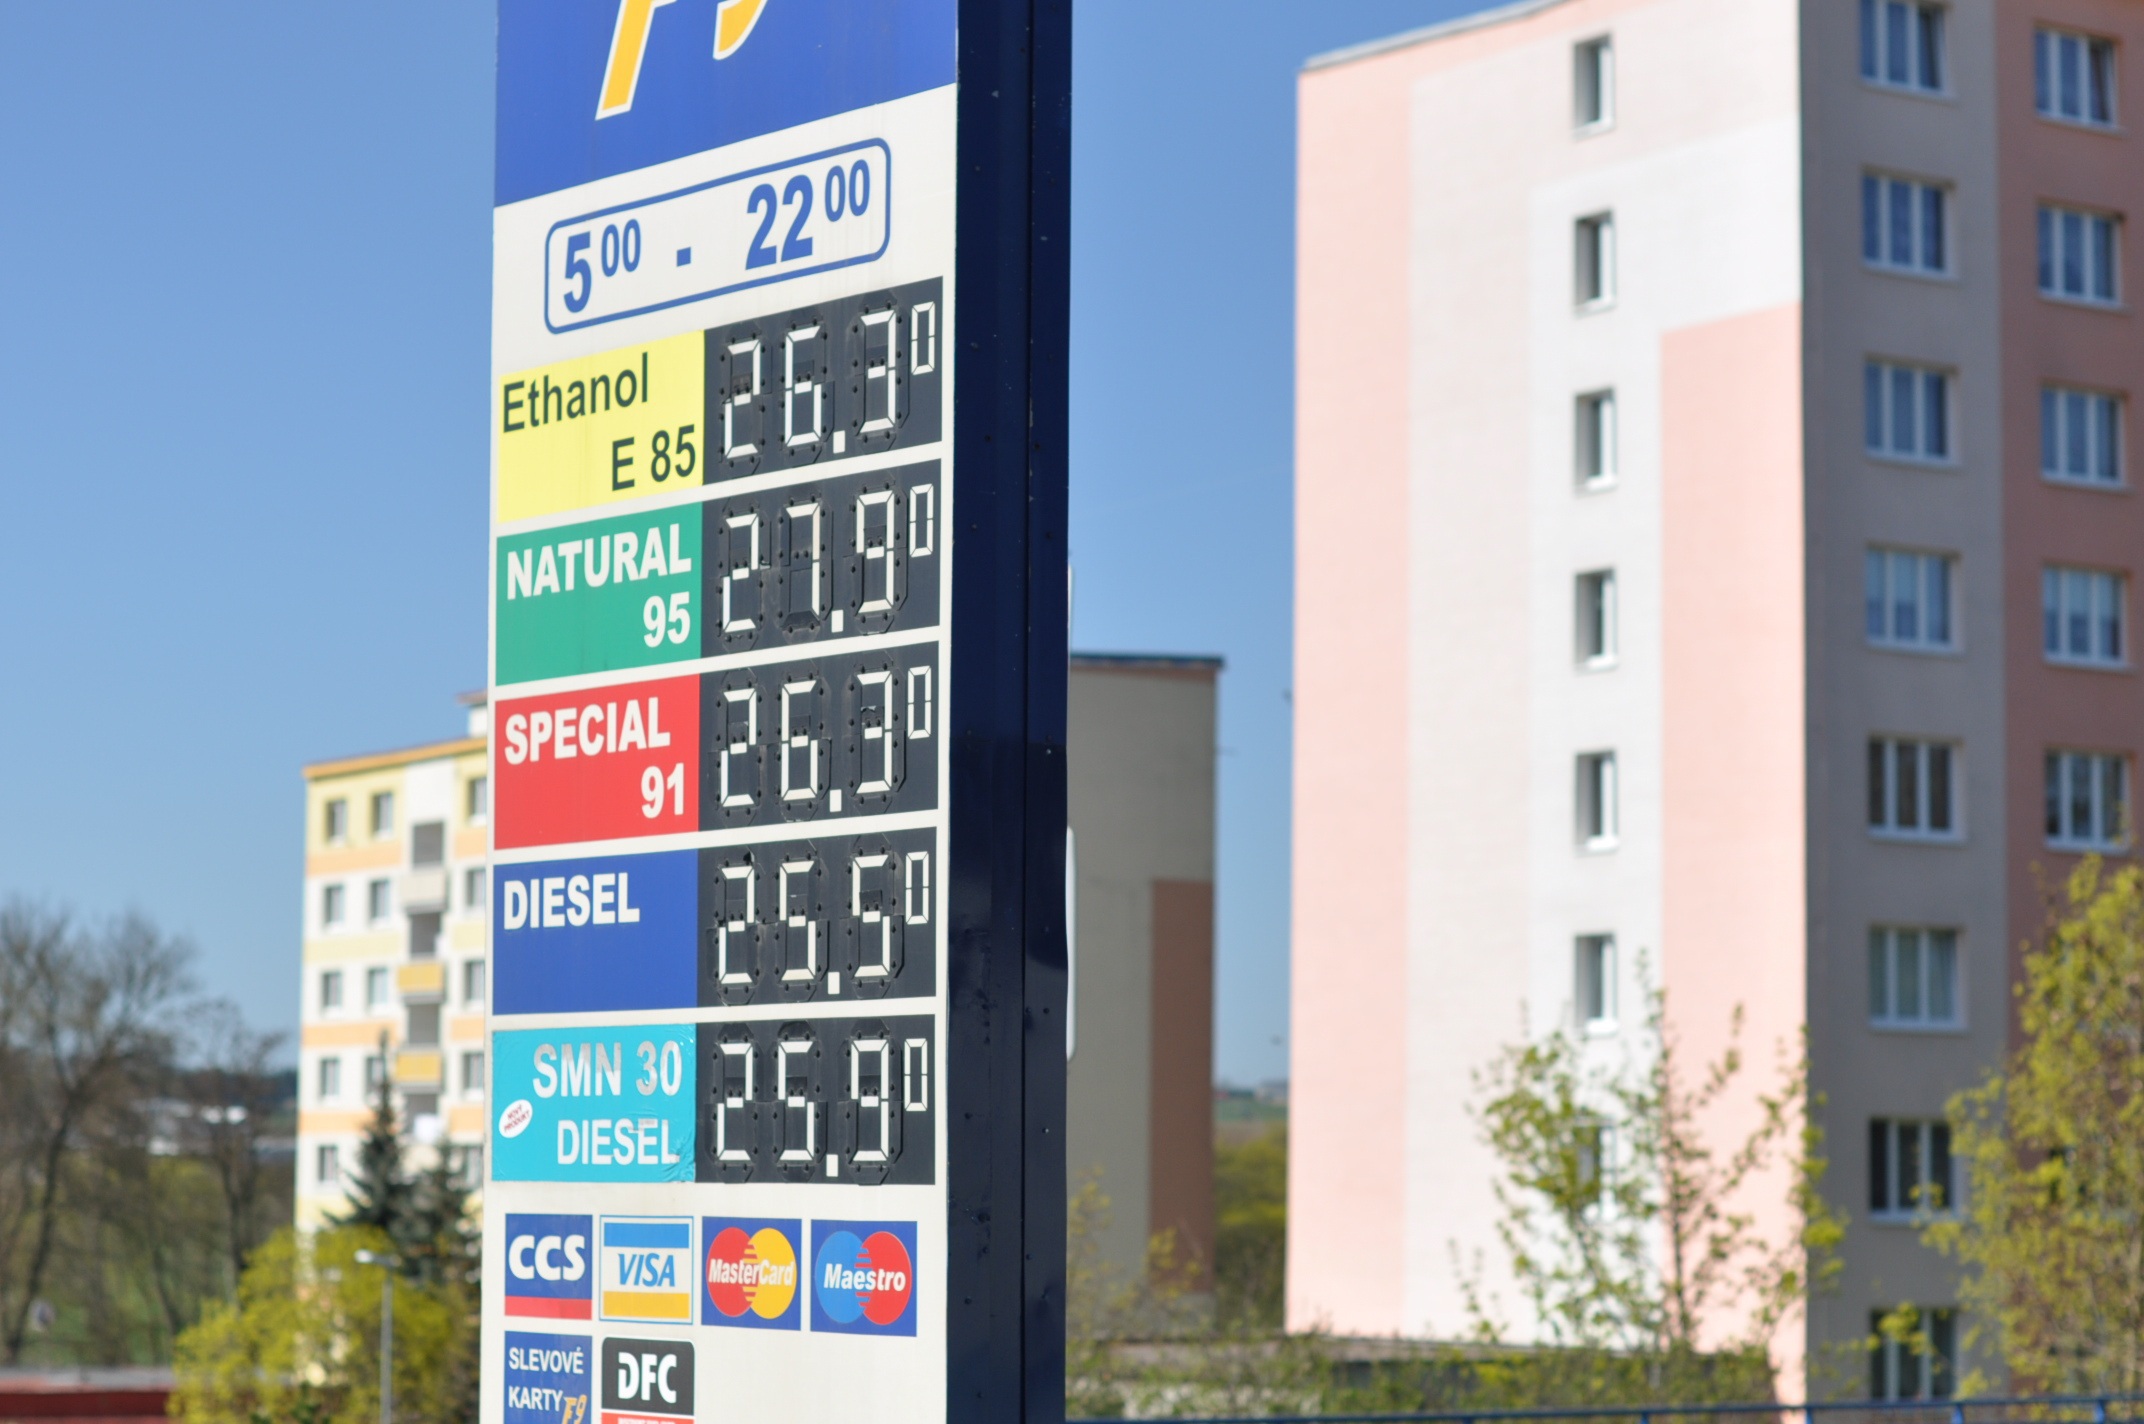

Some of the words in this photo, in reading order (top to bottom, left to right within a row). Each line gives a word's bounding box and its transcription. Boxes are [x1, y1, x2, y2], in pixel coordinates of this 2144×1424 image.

[503, 352, 648, 433] Ethanol
[612, 437, 635, 491] E
[651, 424, 696, 482] 85
[506, 523, 692, 600] NATURAL
[643, 591, 691, 648] 95
[504, 697, 671, 766] SPECIAL
[640, 763, 685, 819] 91
[503, 872, 640, 930] DIESEL
[532, 1042, 622, 1098] SMN
[635, 1040, 683, 1096] 30
[556, 1118, 680, 1165] DIESEL
[508, 1234, 586, 1281] CCS
[617, 1252, 676, 1287] VISA
[708, 1258, 794, 1287] MasterCard
[823, 1263, 907, 1291] Maestro
[508, 1347, 584, 1375] SLEVOVÉ
[617, 1352, 677, 1404] DFC
[508, 1386, 564, 1411] KARTY
